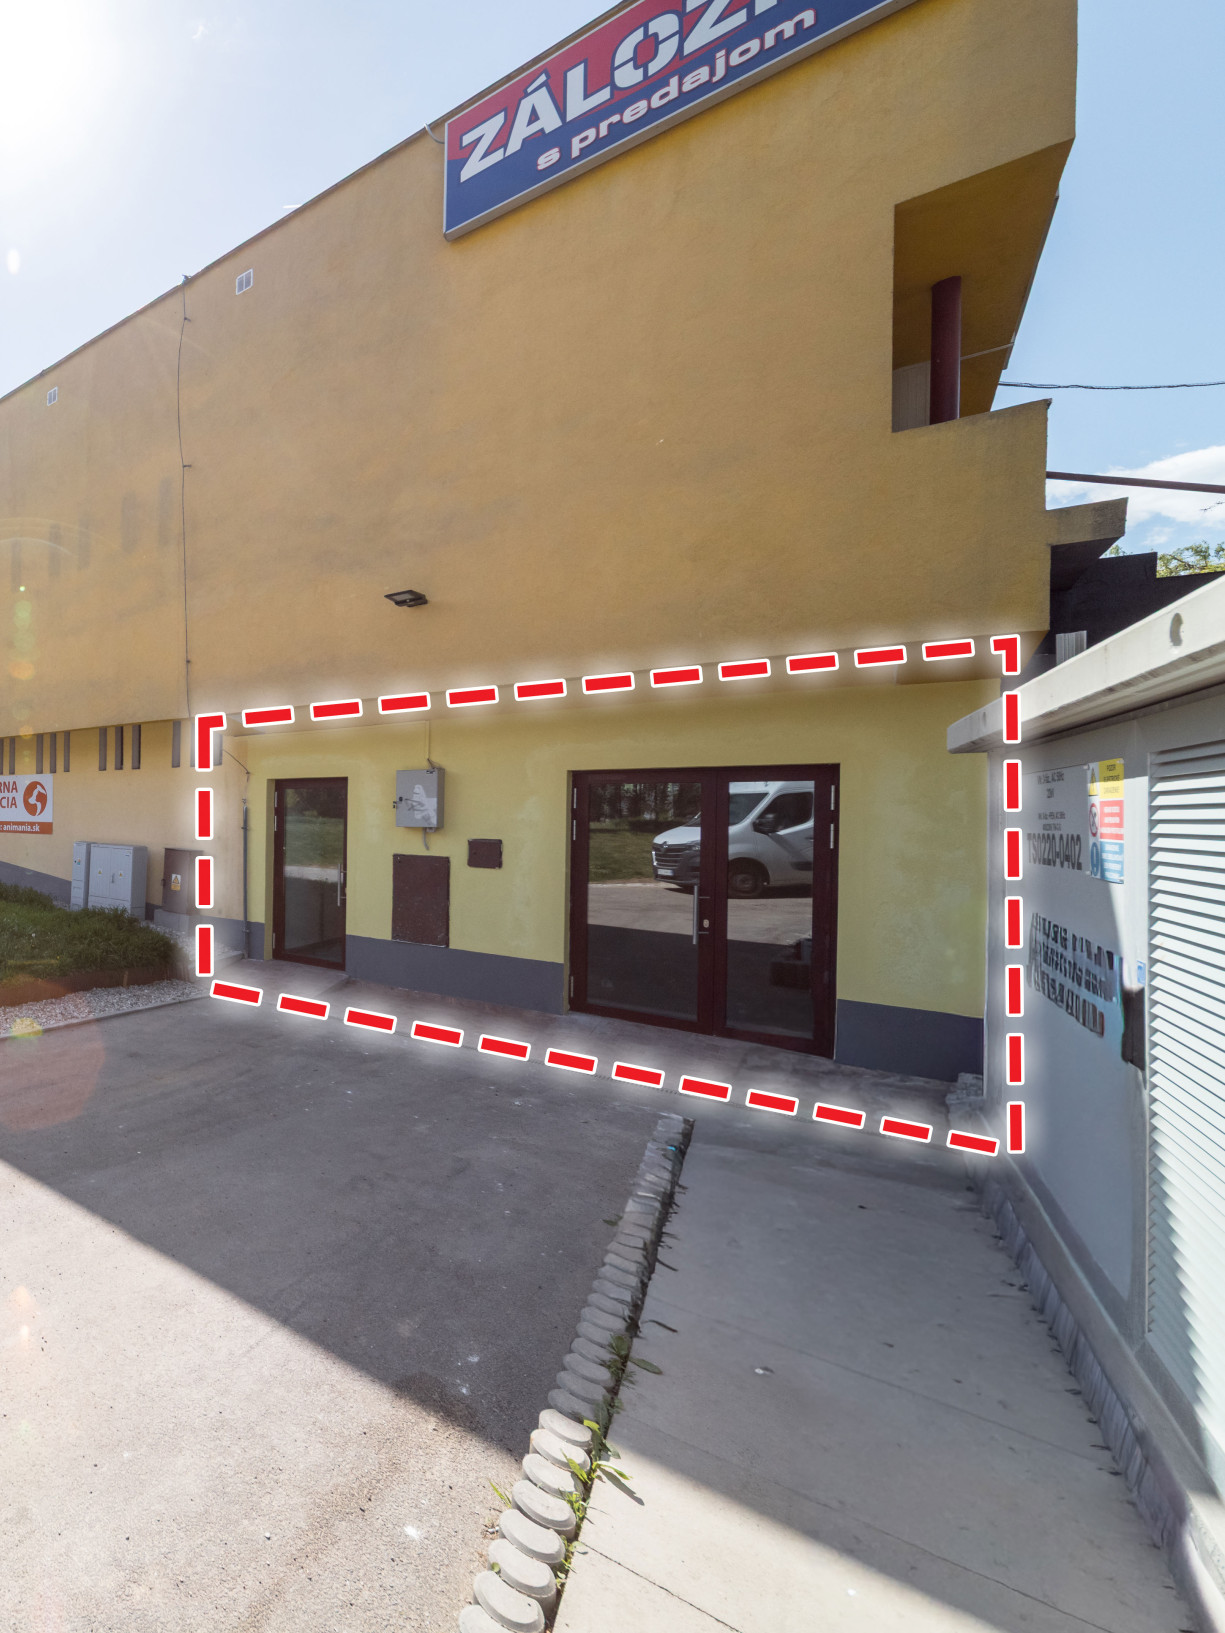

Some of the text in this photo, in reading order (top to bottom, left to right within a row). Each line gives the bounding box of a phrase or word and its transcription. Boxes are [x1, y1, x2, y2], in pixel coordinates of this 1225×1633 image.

[537, 8, 817, 171] s predajom
[3, 824, 40, 832] animania.sk
[1026, 832, 1083, 871] TS0220-0402
